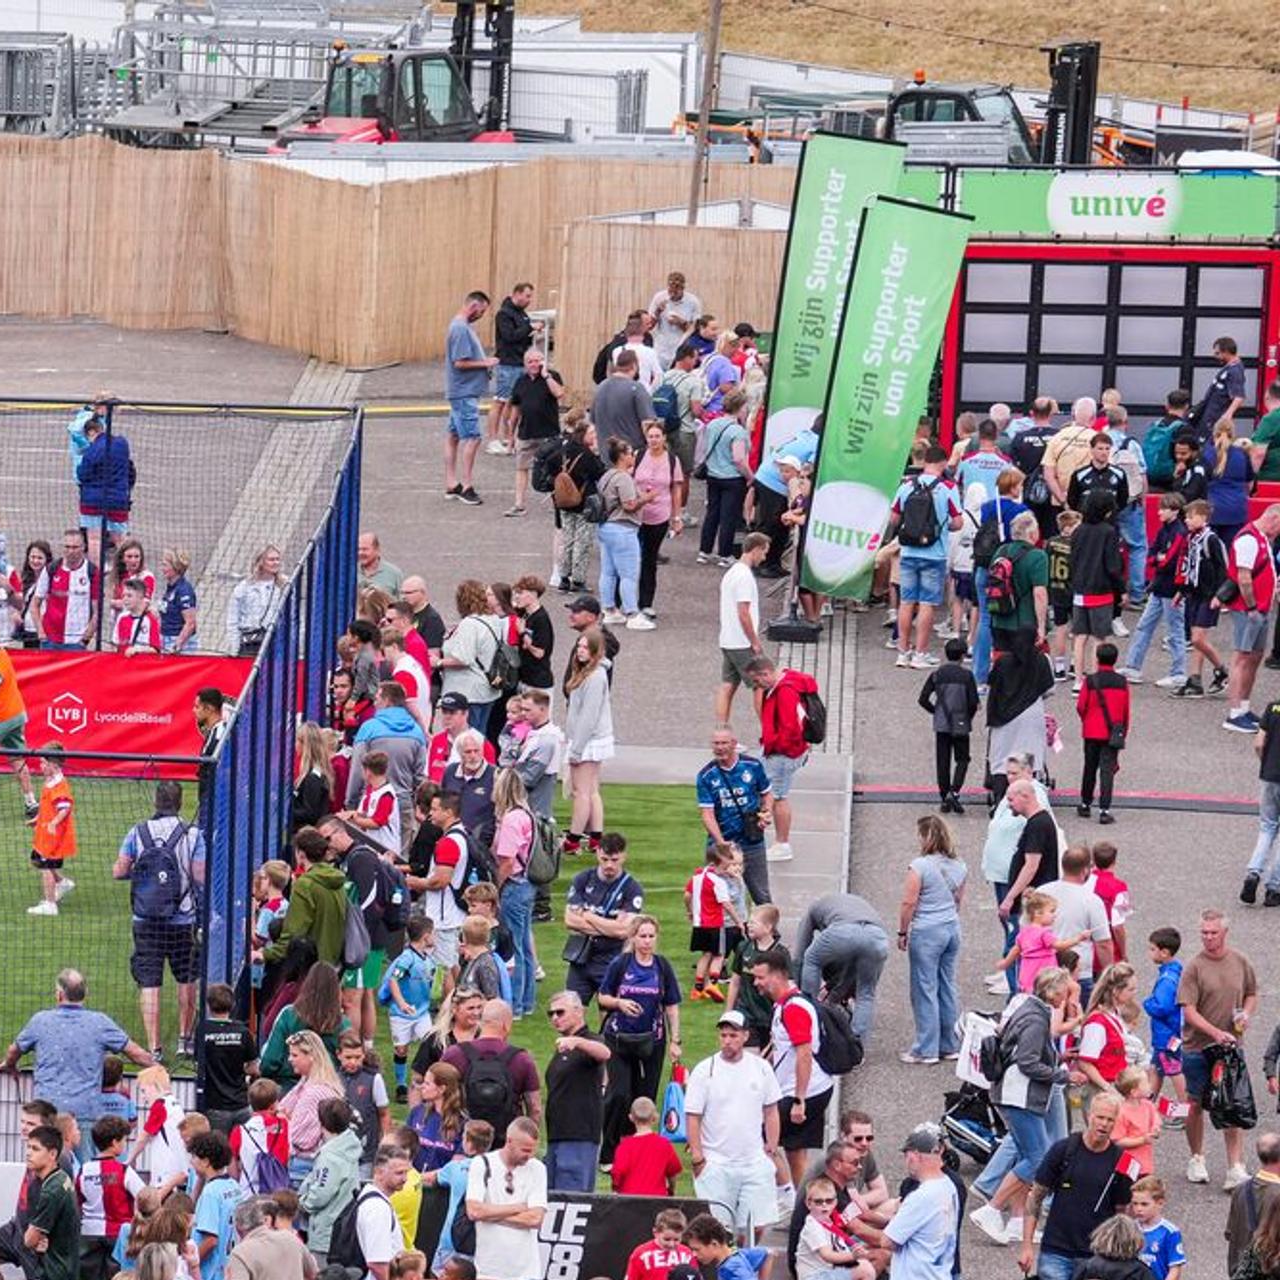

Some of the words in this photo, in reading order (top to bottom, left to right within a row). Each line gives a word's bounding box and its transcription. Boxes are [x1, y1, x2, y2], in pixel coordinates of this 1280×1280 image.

[1070, 188, 1167, 218] univé
[806, 168, 848, 291] Supporter
[861, 242, 909, 366] Supporter
[883, 370, 908, 417] van
[896, 294, 927, 360] Sport
[858, 371, 881, 415] zijn
[1050, 555, 1069, 580] 16
[54, 708, 81, 720] LYB
